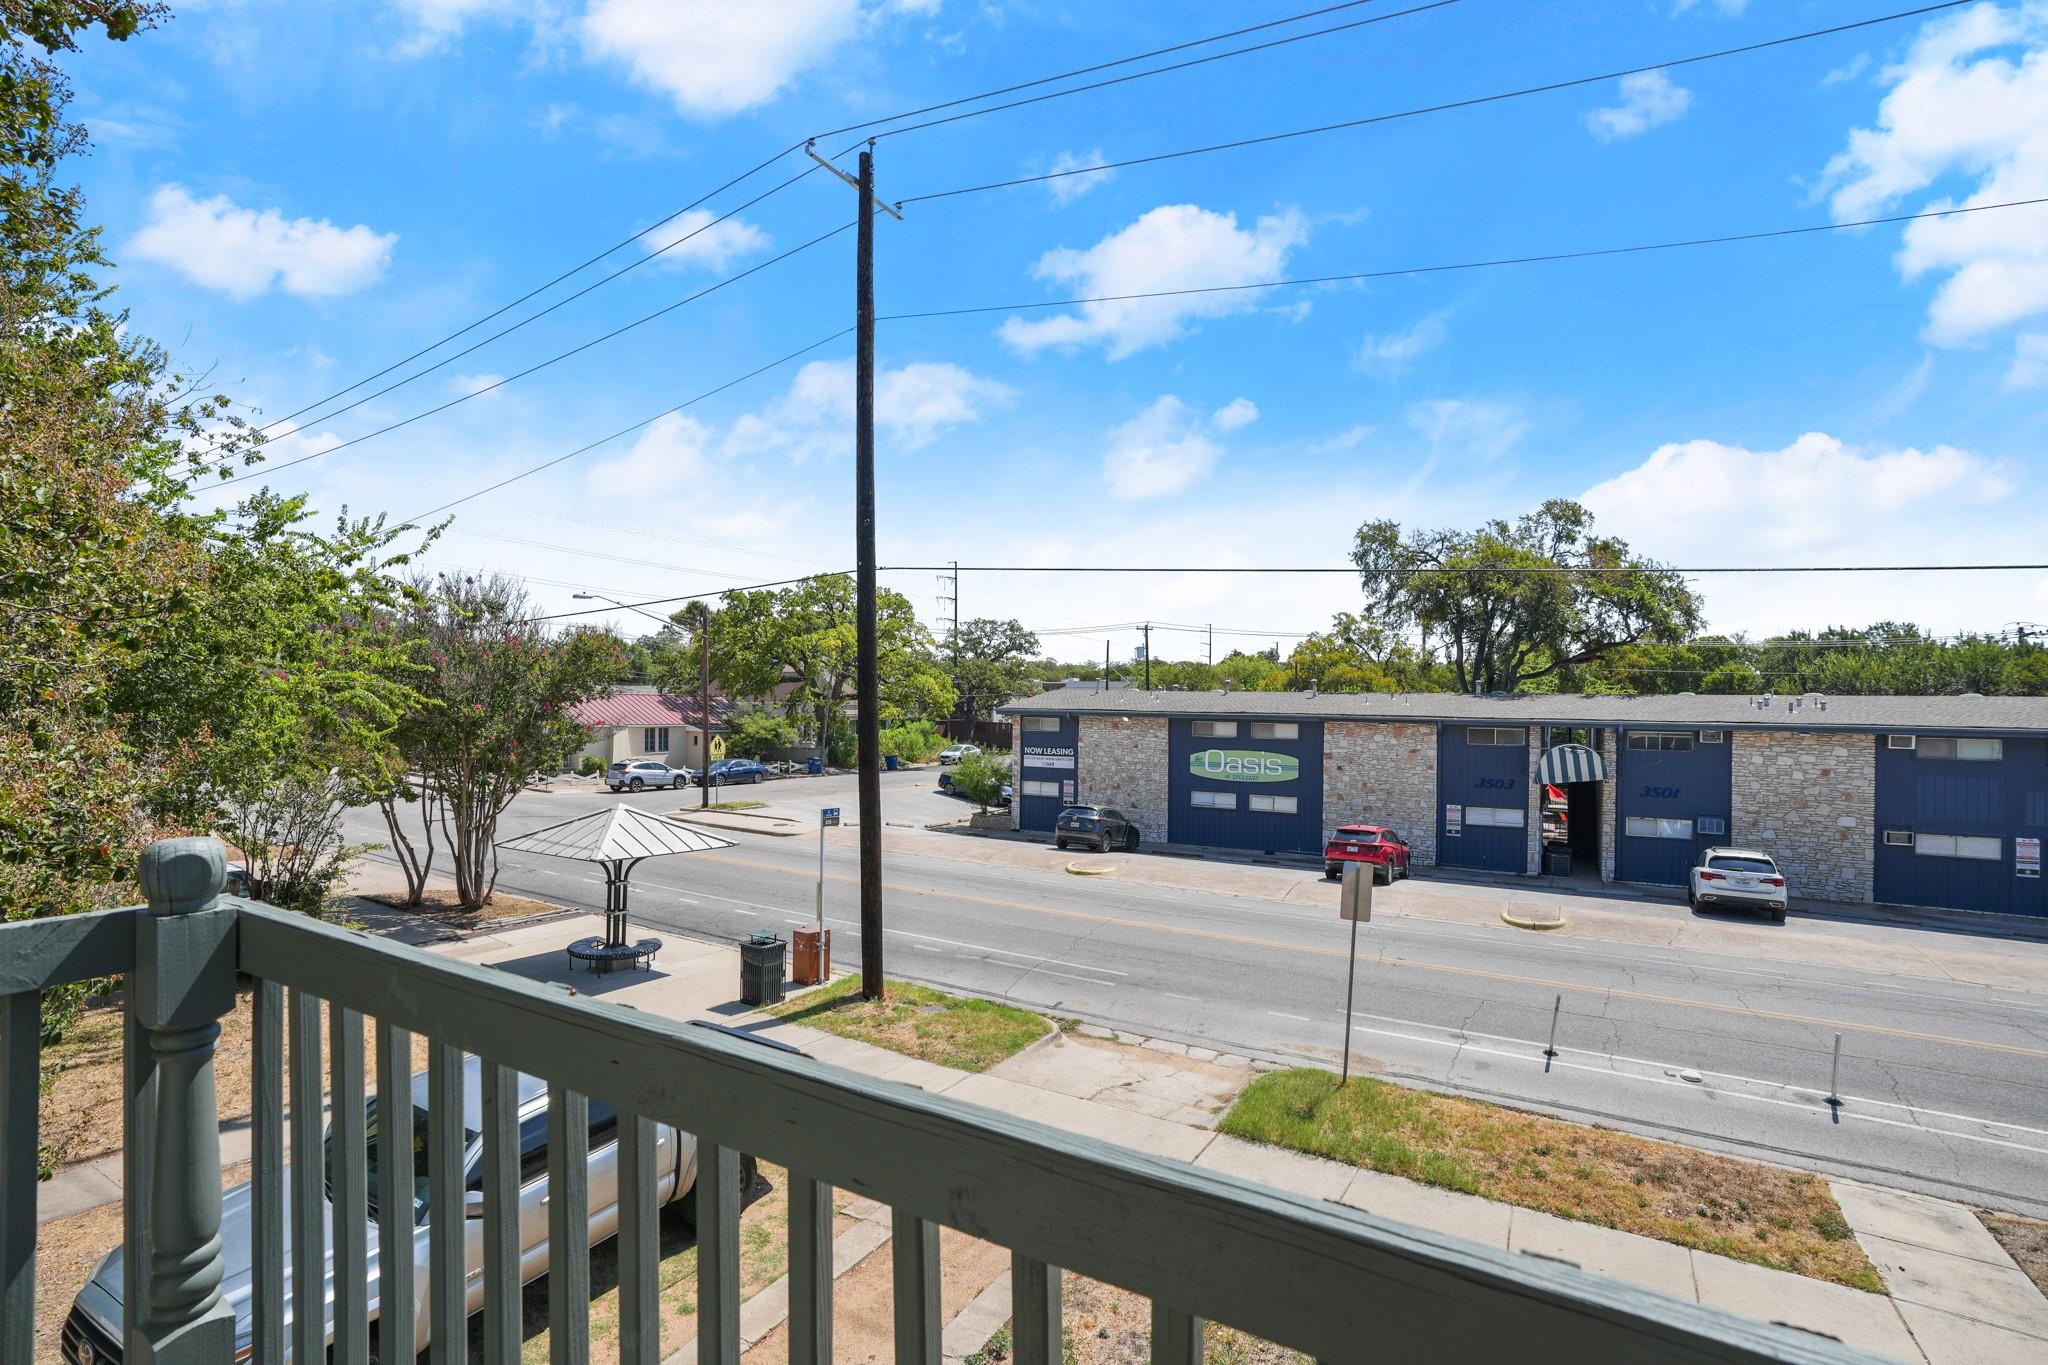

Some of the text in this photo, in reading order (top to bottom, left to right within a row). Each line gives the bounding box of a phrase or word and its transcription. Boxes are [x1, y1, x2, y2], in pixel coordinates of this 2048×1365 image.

[1043, 747, 1074, 755] LEASING
[1205, 749, 1282, 775] Oasis
[1474, 778, 1515, 790] 3503
[1639, 786, 1680, 798] 3501
